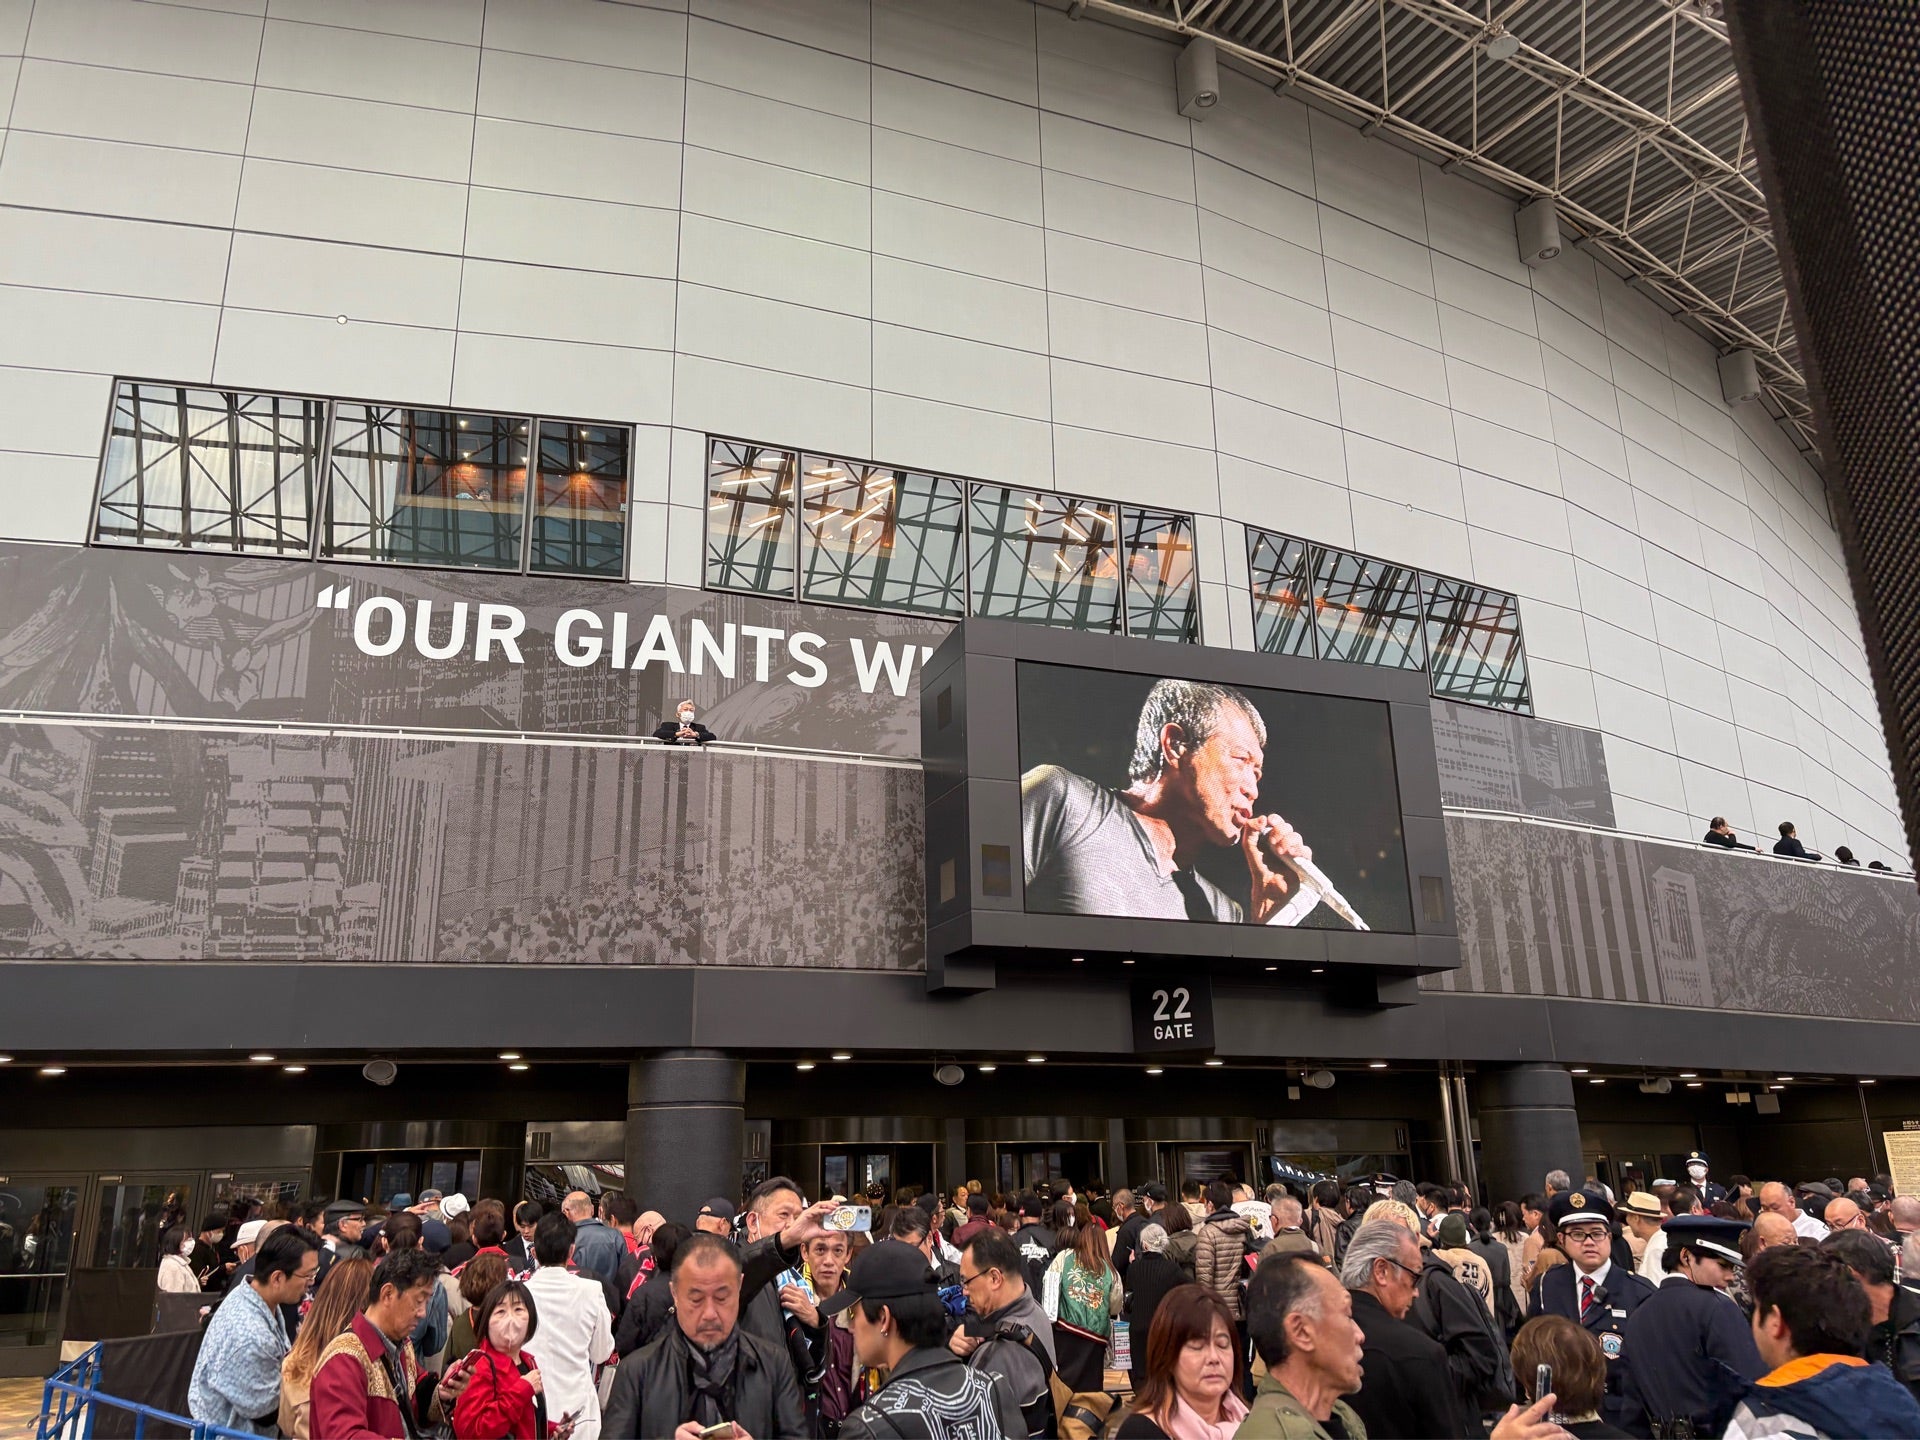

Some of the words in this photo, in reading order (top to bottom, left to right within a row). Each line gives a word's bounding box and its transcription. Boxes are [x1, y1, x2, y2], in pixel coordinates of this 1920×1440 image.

[554, 609, 828, 688] GIANTS
[1152, 987, 1191, 1021] 22
[1153, 1023, 1193, 1040] GATE
